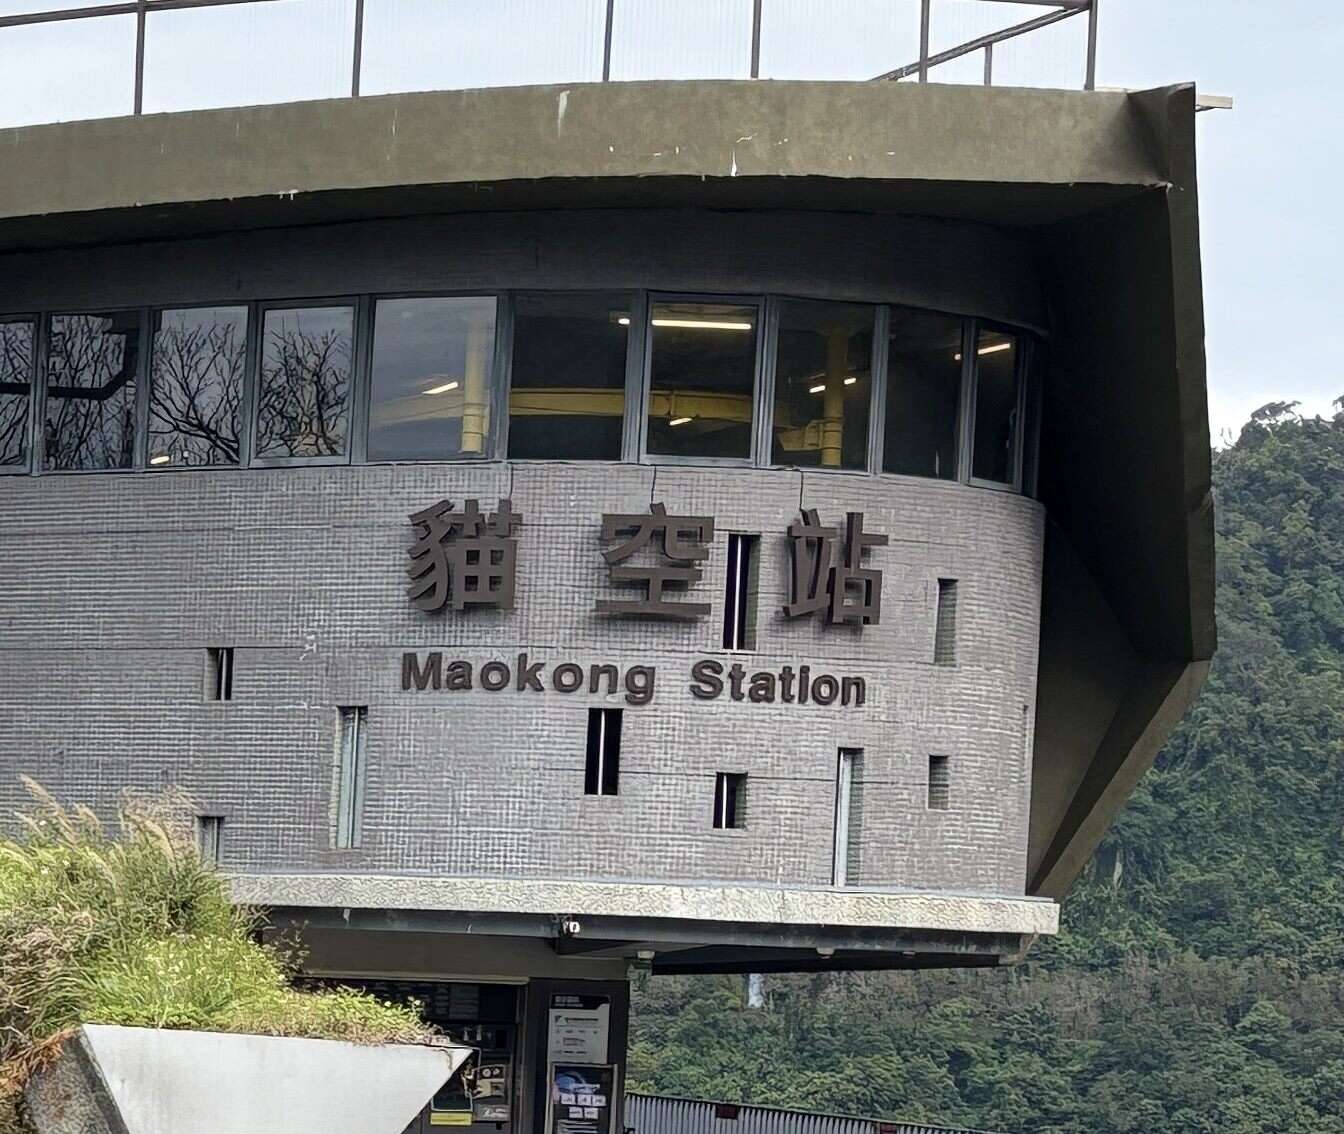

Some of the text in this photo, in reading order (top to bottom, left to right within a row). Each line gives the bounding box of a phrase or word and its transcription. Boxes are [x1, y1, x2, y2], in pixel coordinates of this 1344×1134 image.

[406, 499, 889, 626] 貓空站
[401, 652, 867, 707] Maokong Station
